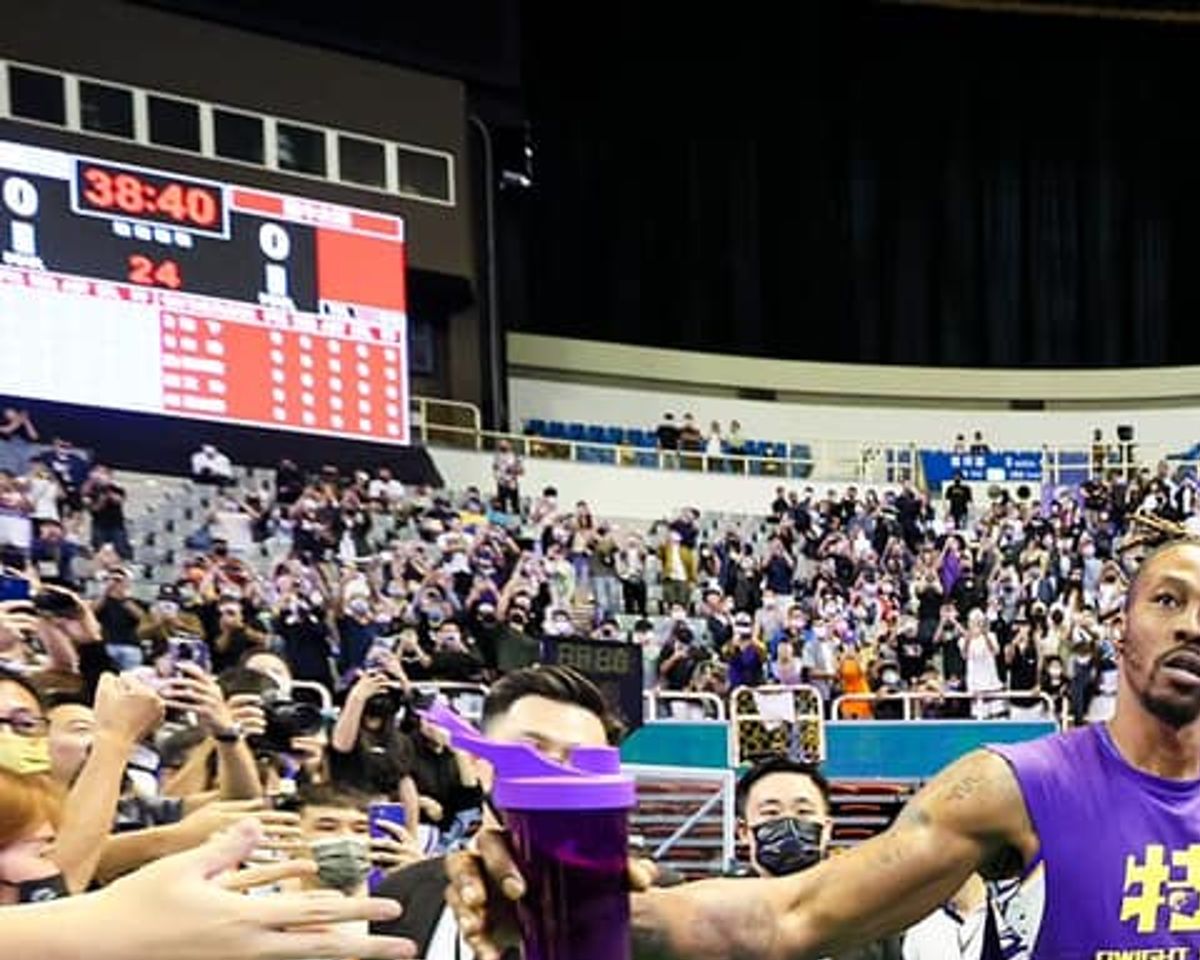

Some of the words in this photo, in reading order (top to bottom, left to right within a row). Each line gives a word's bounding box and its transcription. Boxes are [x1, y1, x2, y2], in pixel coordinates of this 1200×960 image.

[3, 177, 38, 216] 0
[83, 168, 216, 225] 38:40
[259, 222, 290, 261] 0
[127, 254, 181, 288] 24
